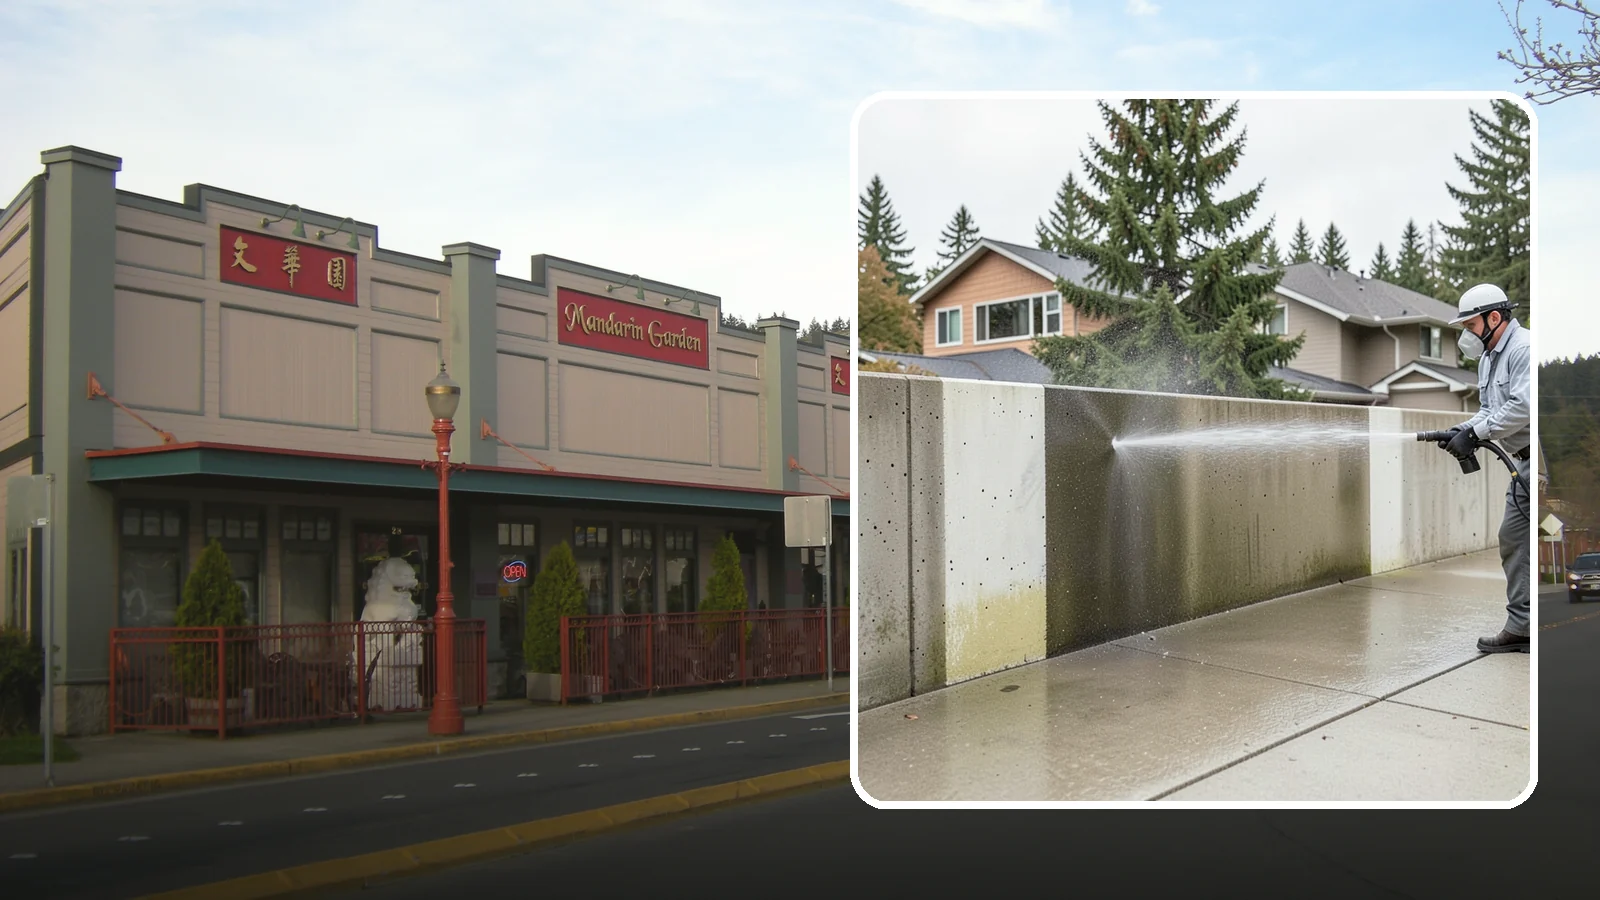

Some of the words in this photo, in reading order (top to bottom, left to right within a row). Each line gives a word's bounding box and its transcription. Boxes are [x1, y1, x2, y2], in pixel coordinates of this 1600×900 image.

[565, 303, 644, 340] Mandarin
[648, 320, 701, 352] Garden
[503, 565, 527, 578] OPEN
